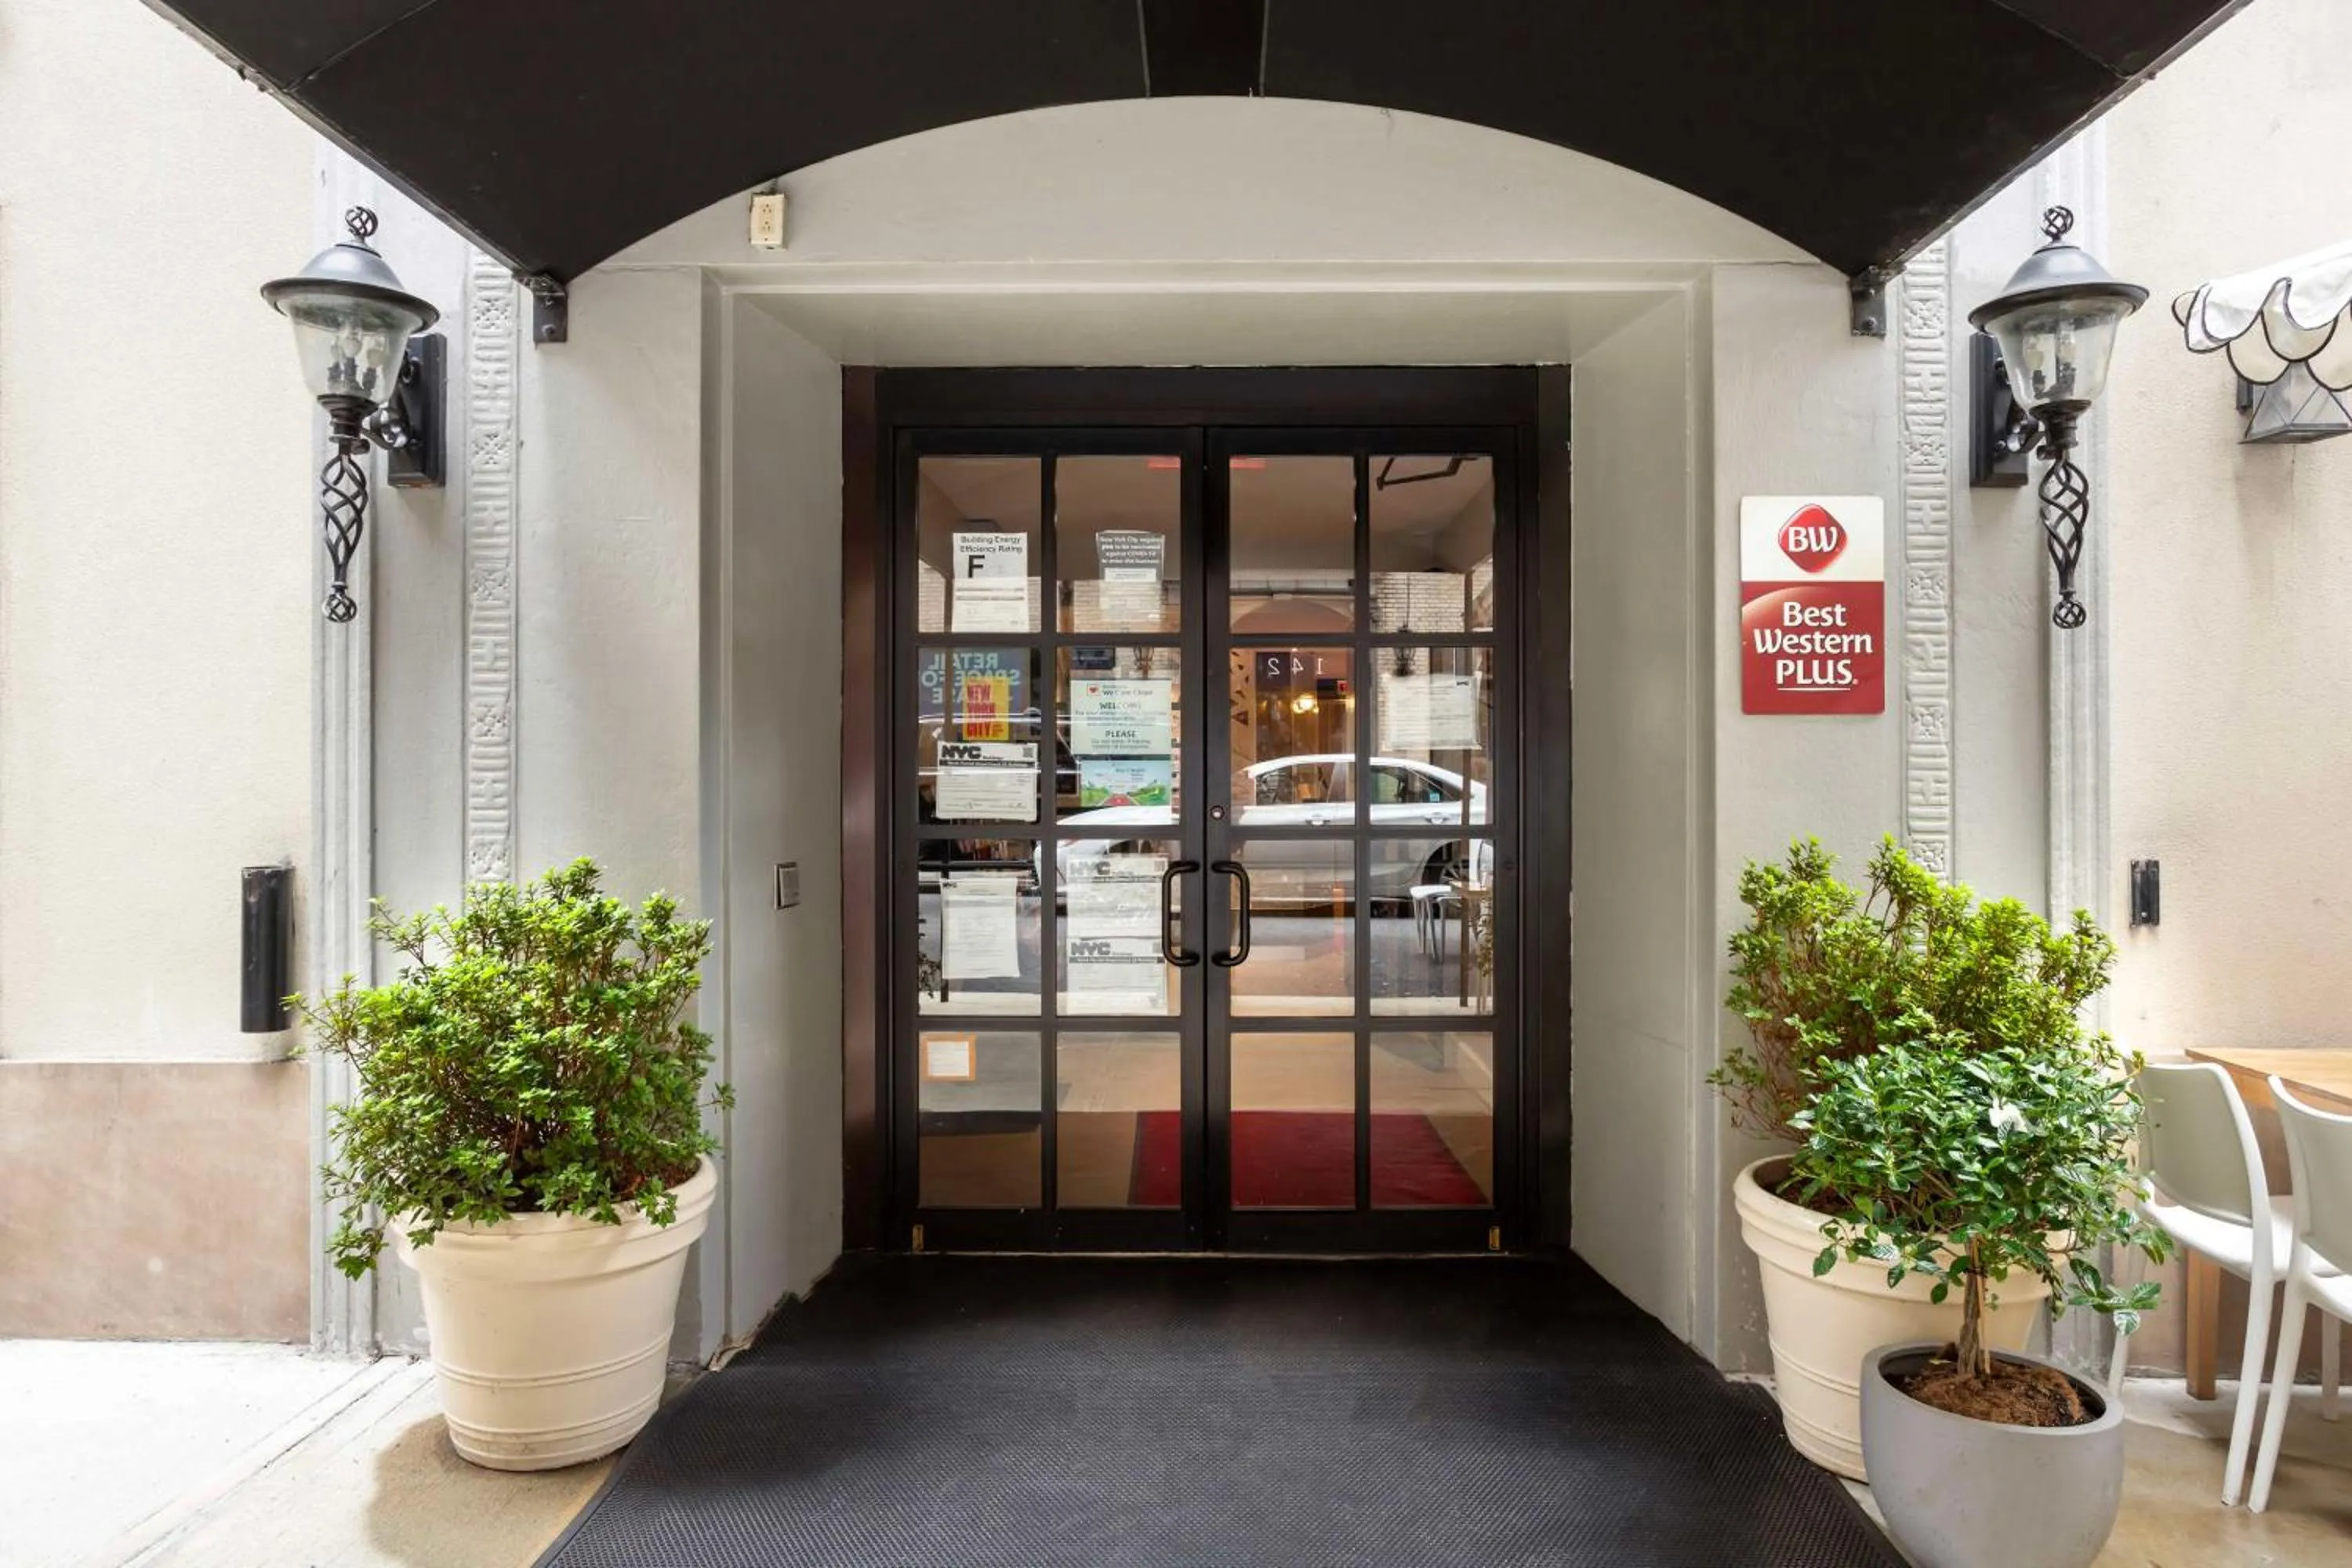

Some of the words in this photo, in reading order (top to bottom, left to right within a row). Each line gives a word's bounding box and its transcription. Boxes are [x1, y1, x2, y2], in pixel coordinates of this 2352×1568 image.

[960, 545, 996, 554] Efficiency
[998, 545, 1023, 554] Rating
[1788, 526, 1838, 552] BW
[968, 555, 985, 578] F
[1784, 601, 1846, 626] Best
[1753, 628, 1872, 653] Western
[942, 745, 981, 760] NYC
[1070, 942, 1111, 955] NYC
